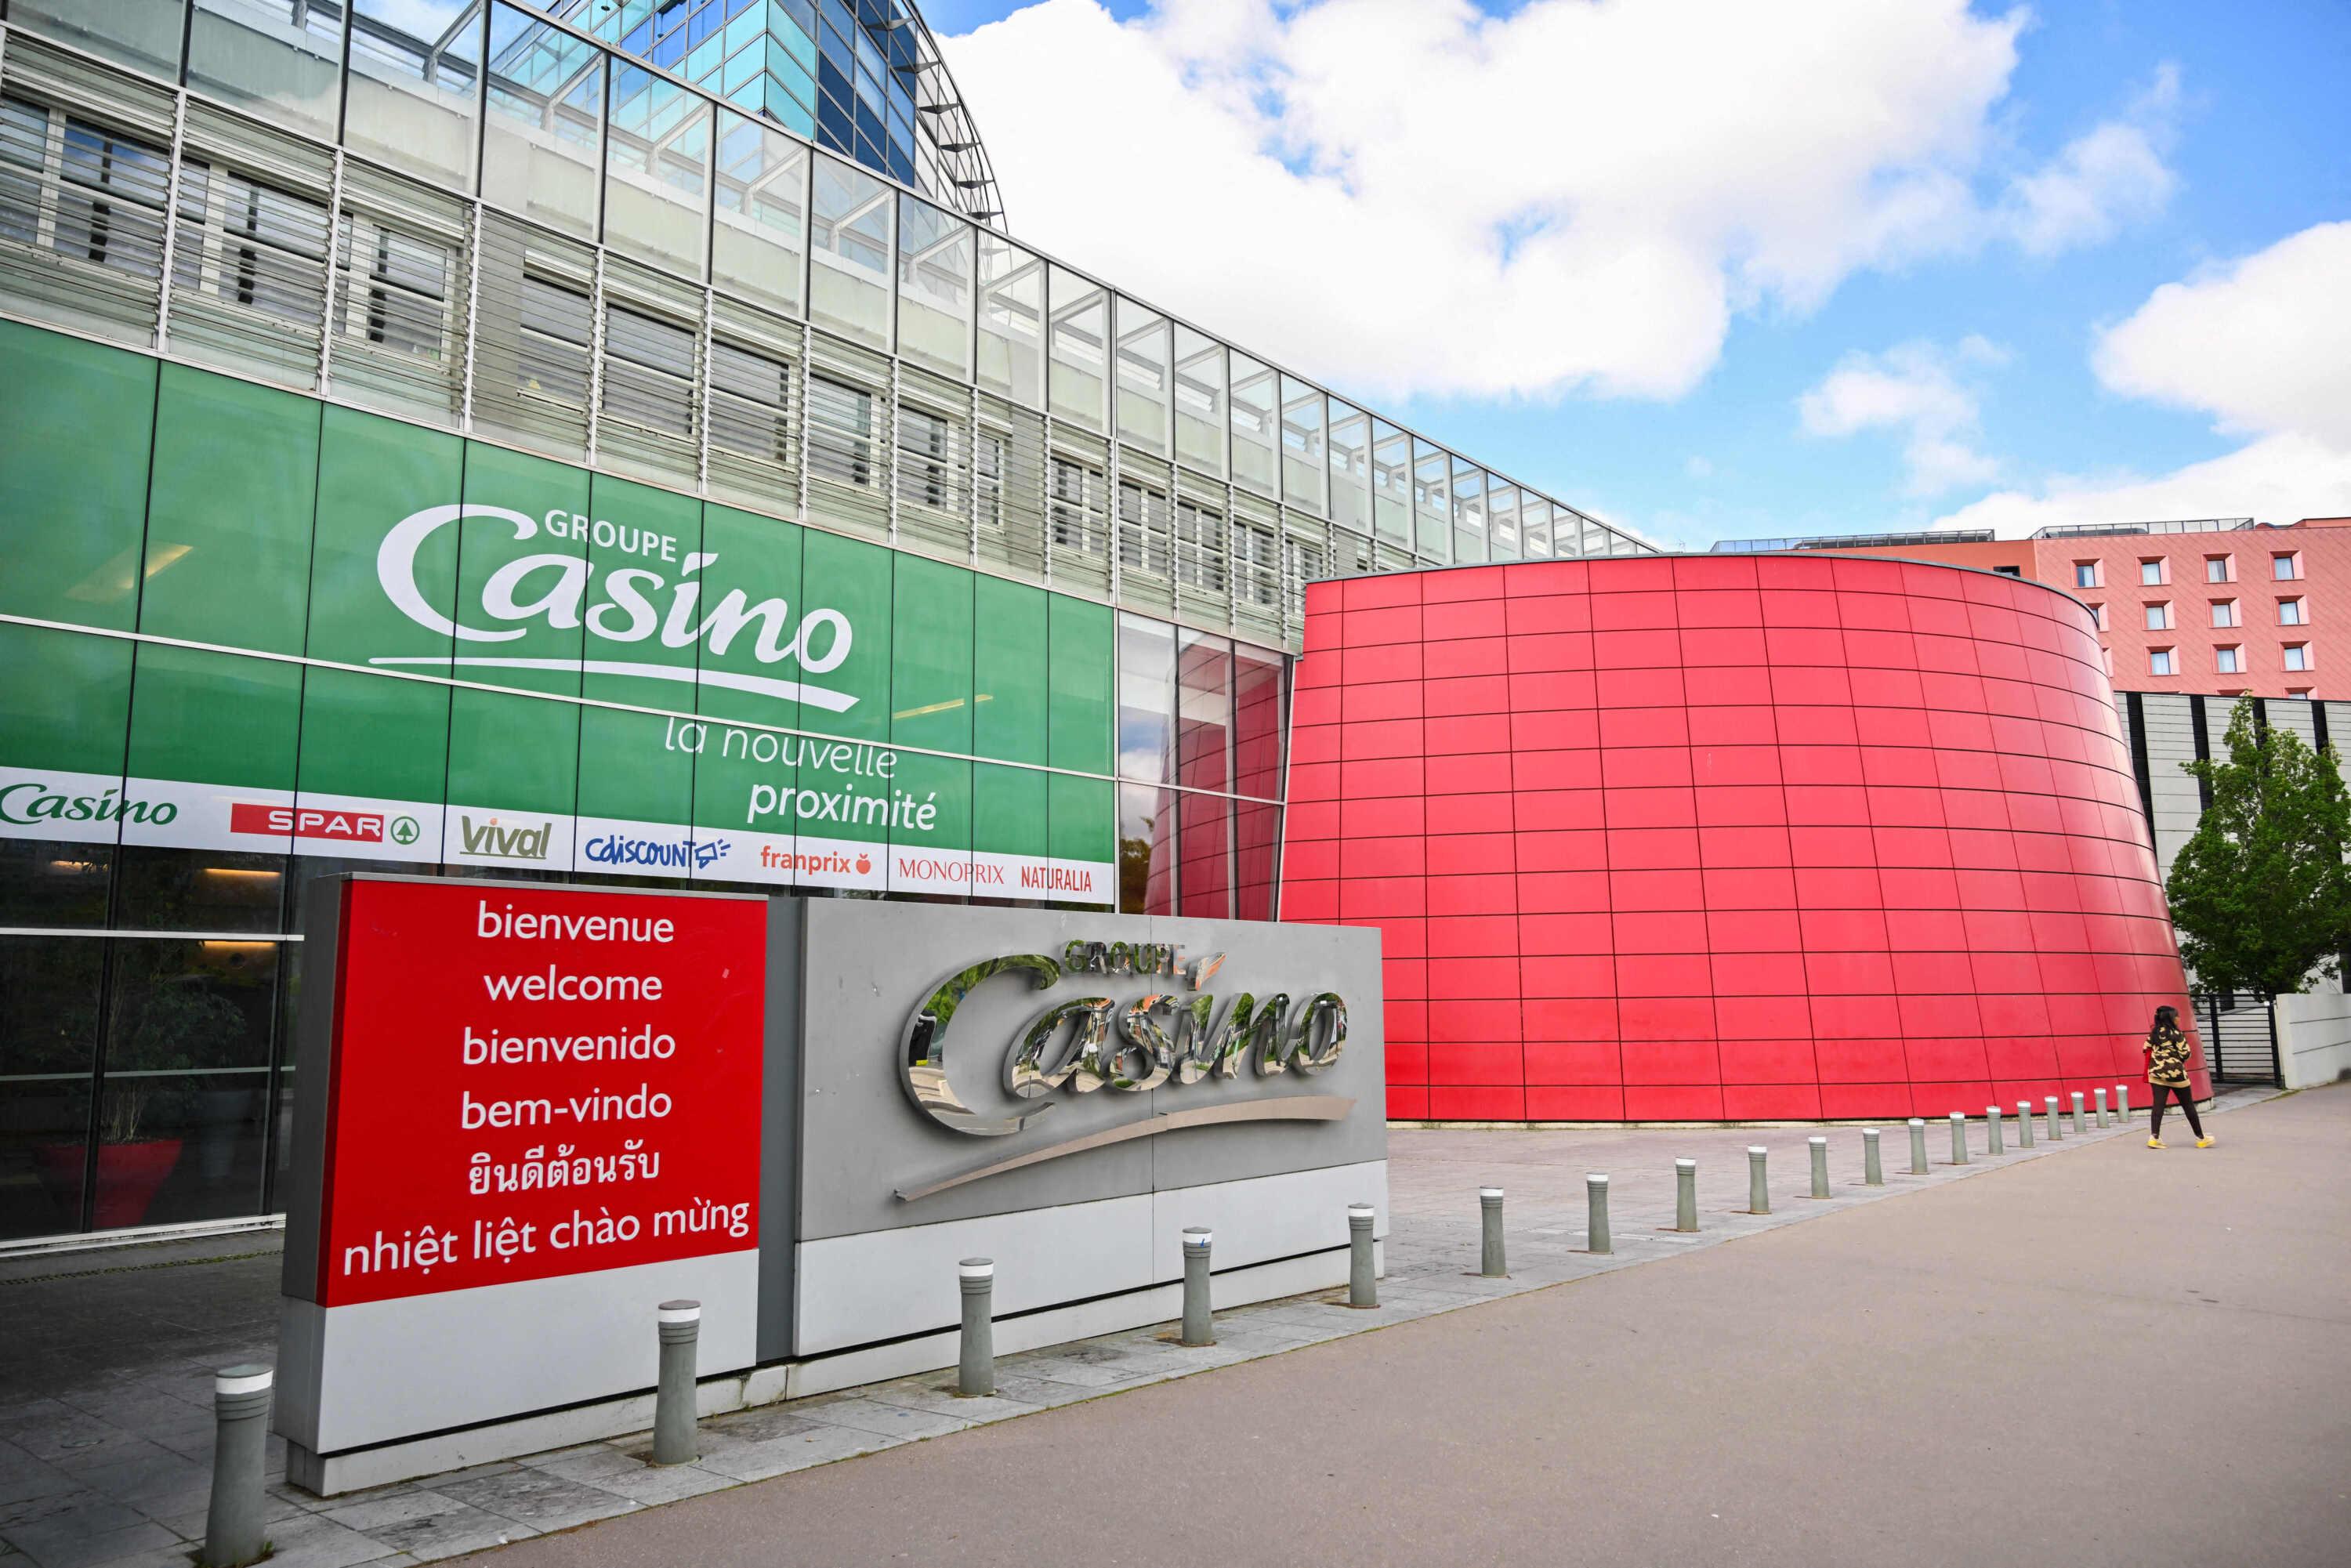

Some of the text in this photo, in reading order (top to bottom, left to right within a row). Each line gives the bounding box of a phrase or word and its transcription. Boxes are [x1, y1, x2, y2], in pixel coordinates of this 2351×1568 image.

[545, 509, 677, 563] GROUPE
[377, 504, 853, 673] Casino
[665, 716, 898, 779] la nouvelle
[0, 784, 178, 826] Casino
[268, 810, 381, 836] SPAR
[747, 784, 937, 831] proximité
[462, 815, 552, 857] Vival
[760, 846, 851, 874] franprix
[900, 858, 1005, 885] MONOPRIX
[1021, 866, 1092, 893] NATURALIA
[477, 900, 675, 943] bienvenue
[1061, 940, 1186, 974] GROUPE
[484, 965, 663, 1001] welcome
[462, 1024, 676, 1065] bienvenido
[899, 952, 1349, 1135] Casino
[461, 1083, 672, 1130] bem-vindo
[469, 1139, 661, 1194] ยินดีต้อนรับ
[343, 1197, 750, 1276] nhiệt liệt chào mừng
